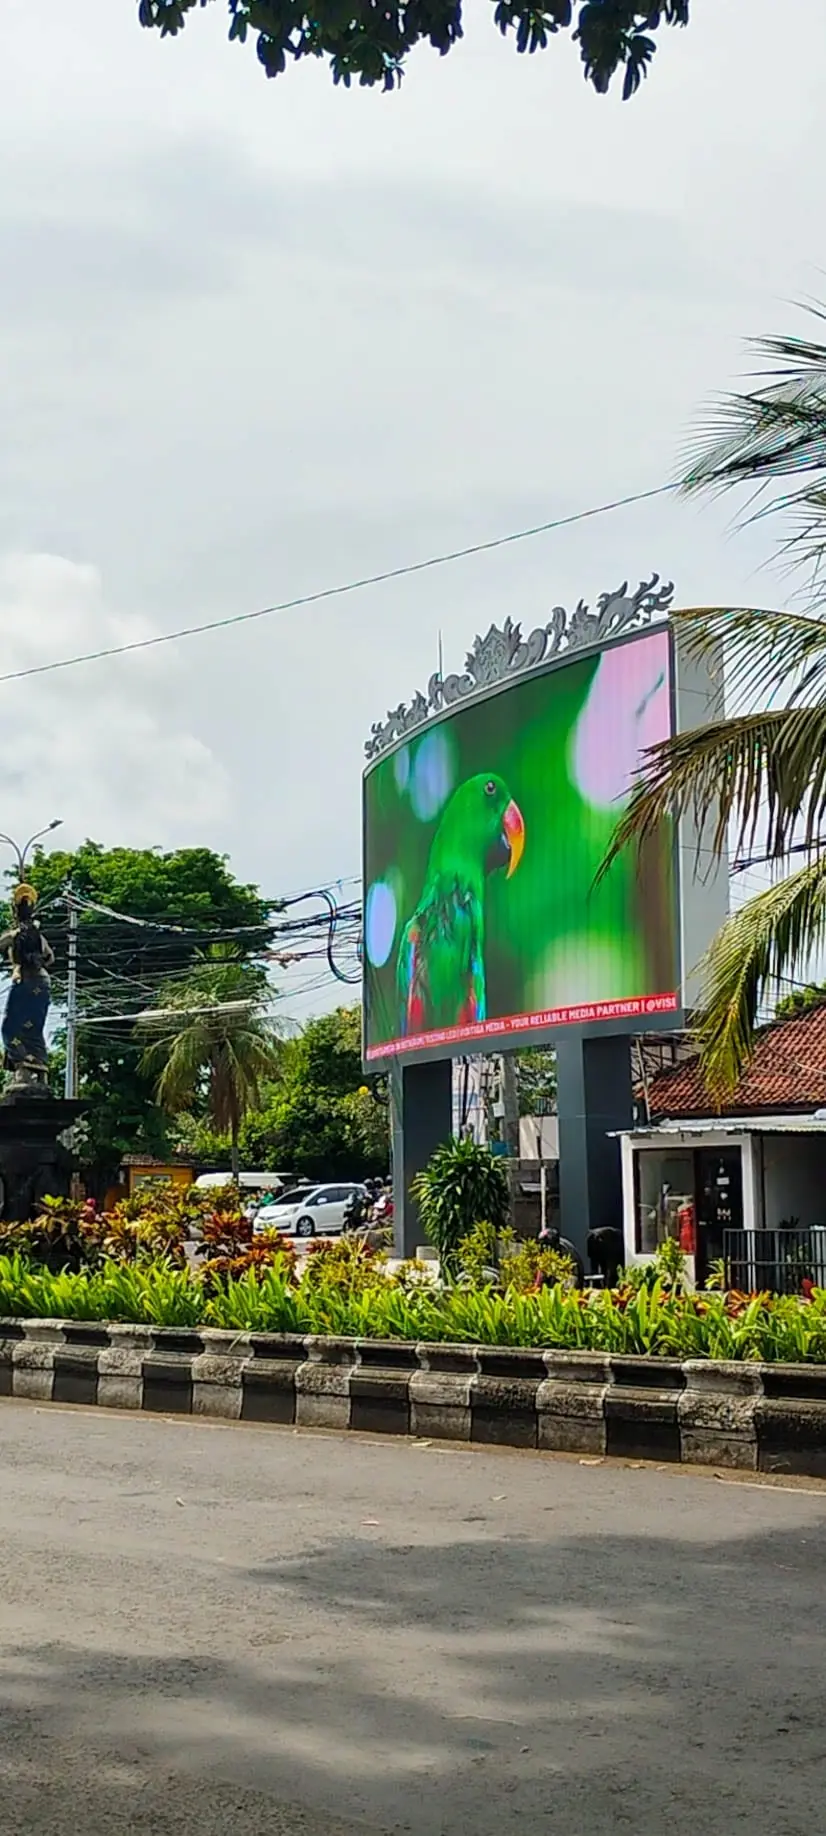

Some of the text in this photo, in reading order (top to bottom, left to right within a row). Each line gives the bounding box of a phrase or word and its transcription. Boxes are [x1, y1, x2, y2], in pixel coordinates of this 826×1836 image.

[530, 1011, 568, 1025] RELIABLE
[568, 1006, 595, 1020] MEDIA
[596, 1001, 640, 1017] PARTNER
